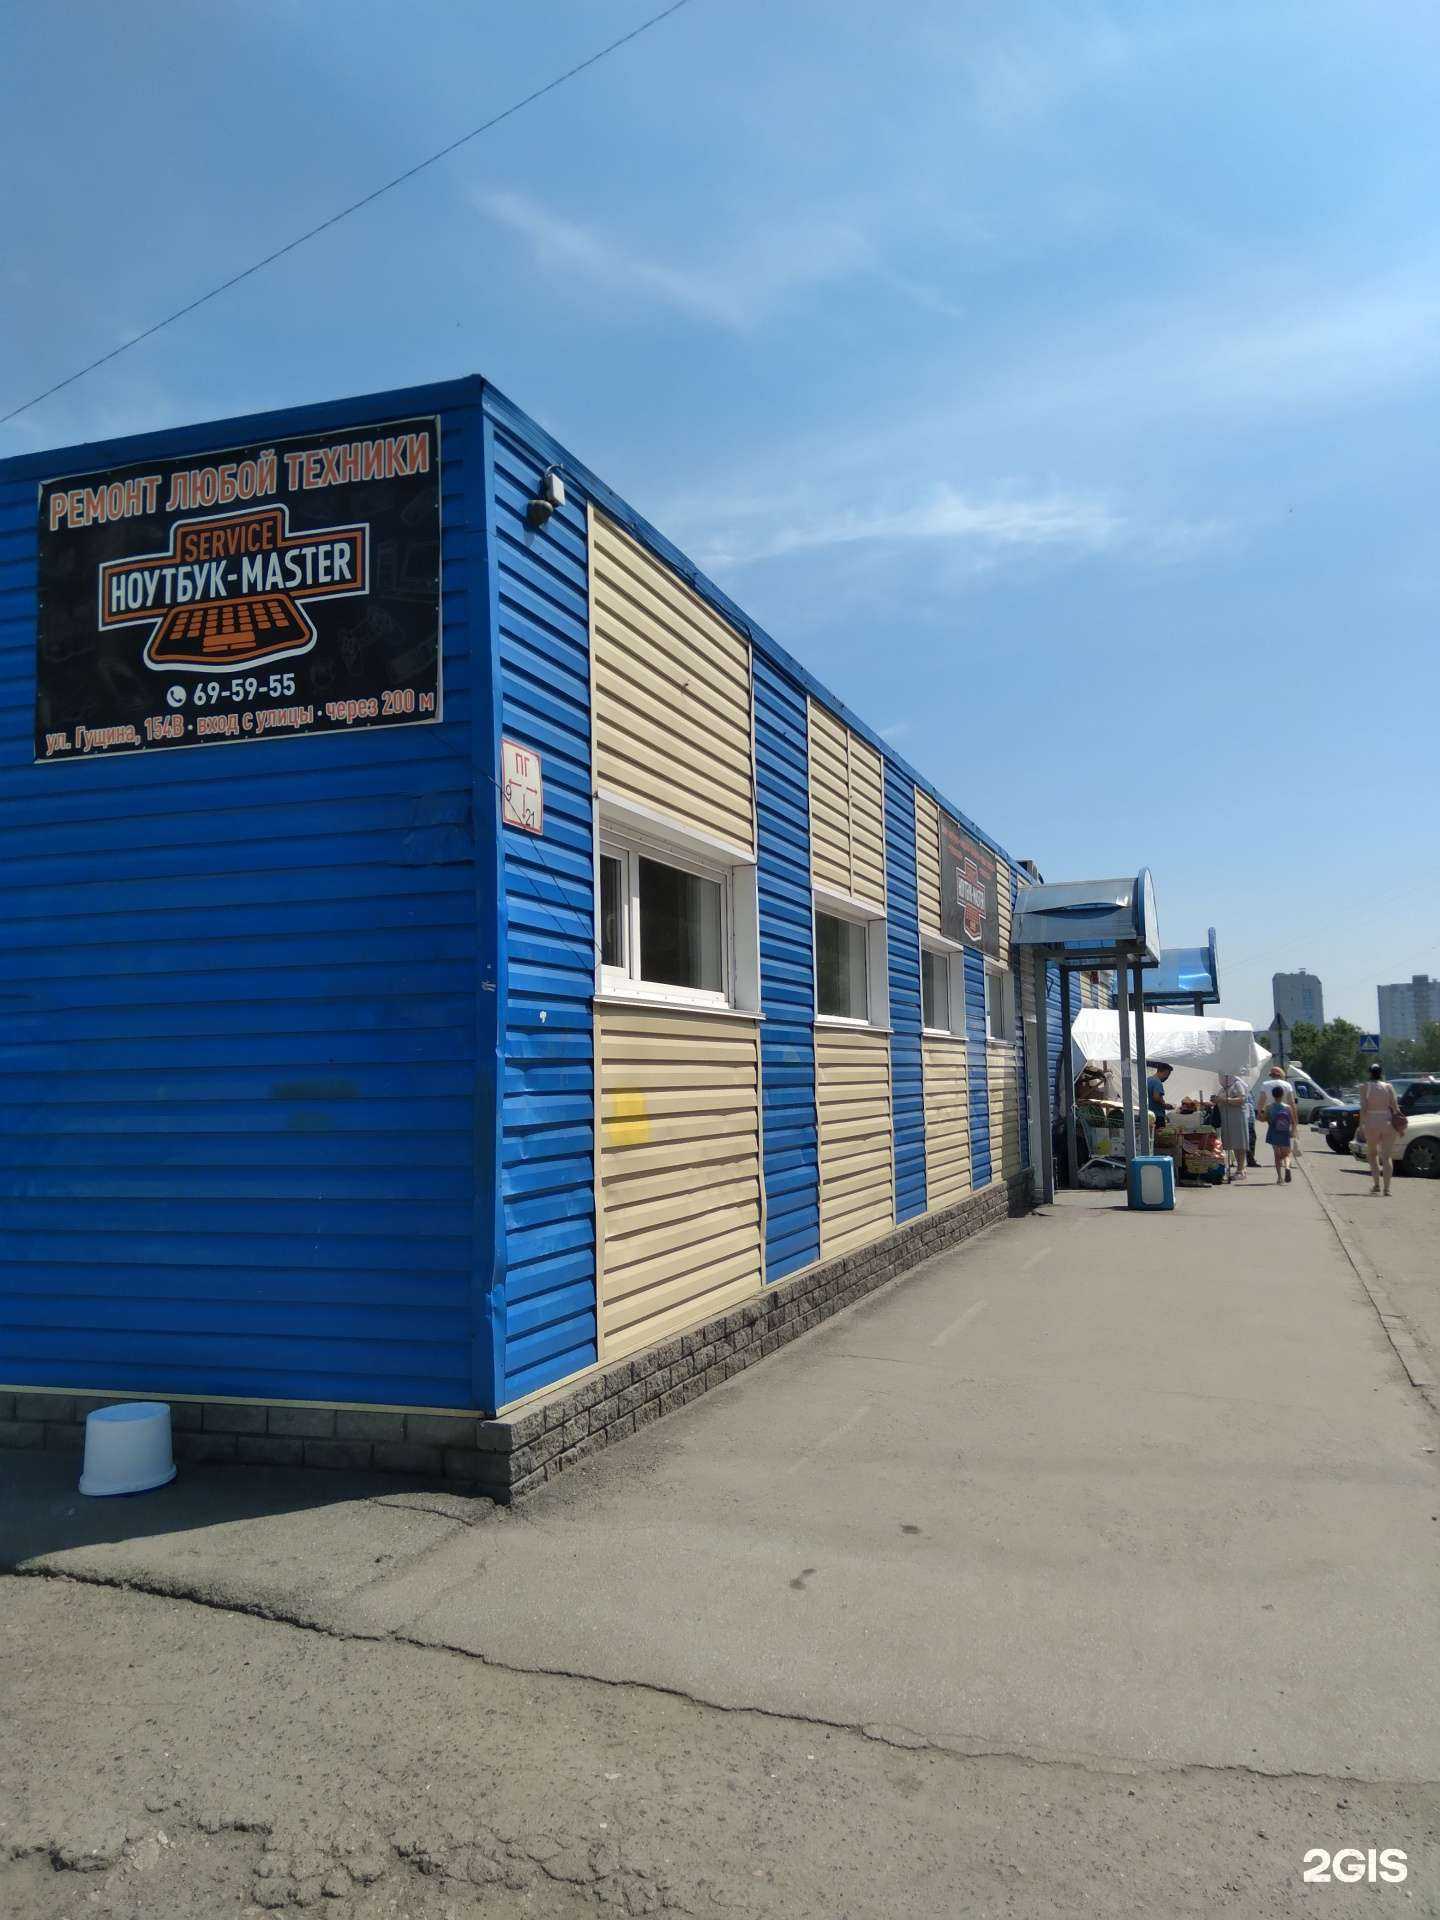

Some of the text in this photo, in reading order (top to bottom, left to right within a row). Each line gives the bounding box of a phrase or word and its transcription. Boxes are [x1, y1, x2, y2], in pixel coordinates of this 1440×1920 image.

[49, 432, 430, 532] РЕМОНТ ЛЮБОЙ ТЕХНИКИ
[184, 519, 275, 563] SERVICE
[110, 542, 353, 612] НОУТБУК-MASTER
[193, 673, 296, 706] 69-59-55
[46, 688, 435, 756] ул. Гущина, 154В вход с улицы через 200 м
[515, 752, 531, 778] ПГ
